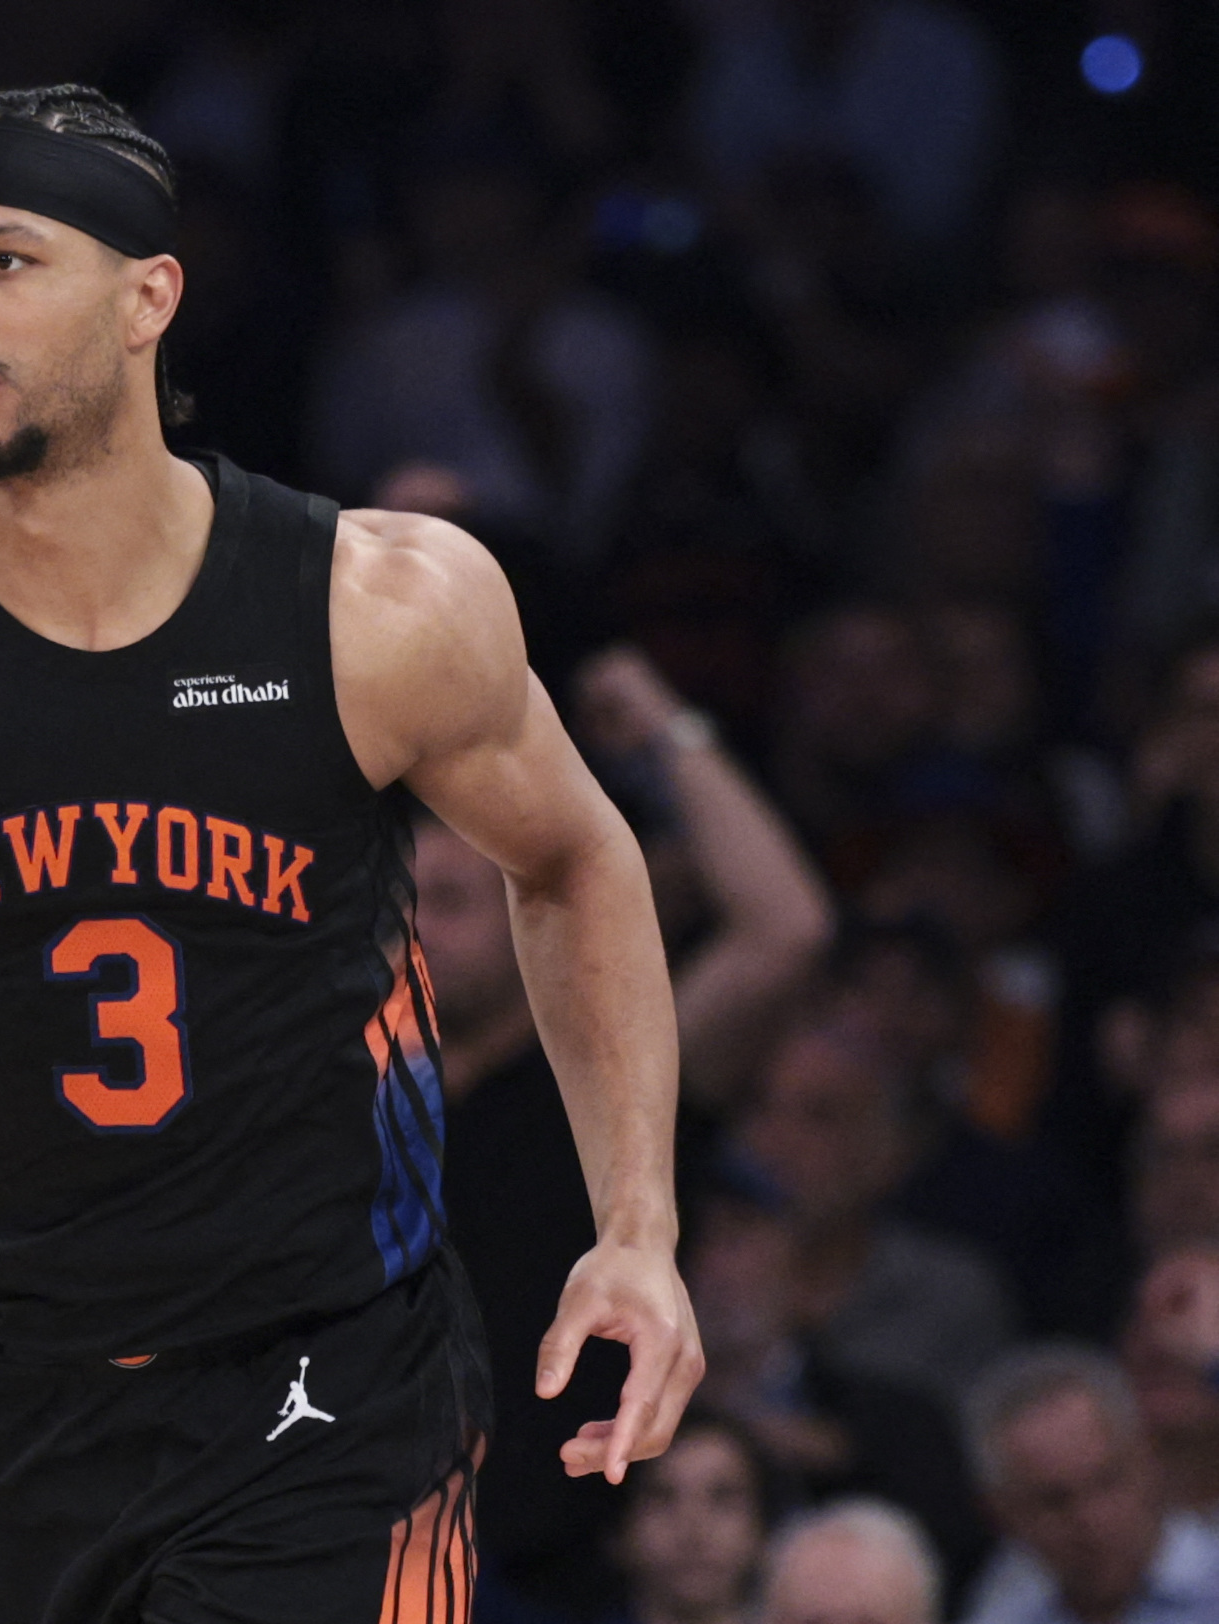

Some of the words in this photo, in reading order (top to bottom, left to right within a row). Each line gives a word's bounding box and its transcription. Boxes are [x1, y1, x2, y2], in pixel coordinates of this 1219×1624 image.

[173, 674, 236, 688] experience
[173, 687, 218, 708] abu
[221, 679, 289, 704] dhabi
[93, 801, 315, 925] YORK
[44, 913, 192, 1132] 3
